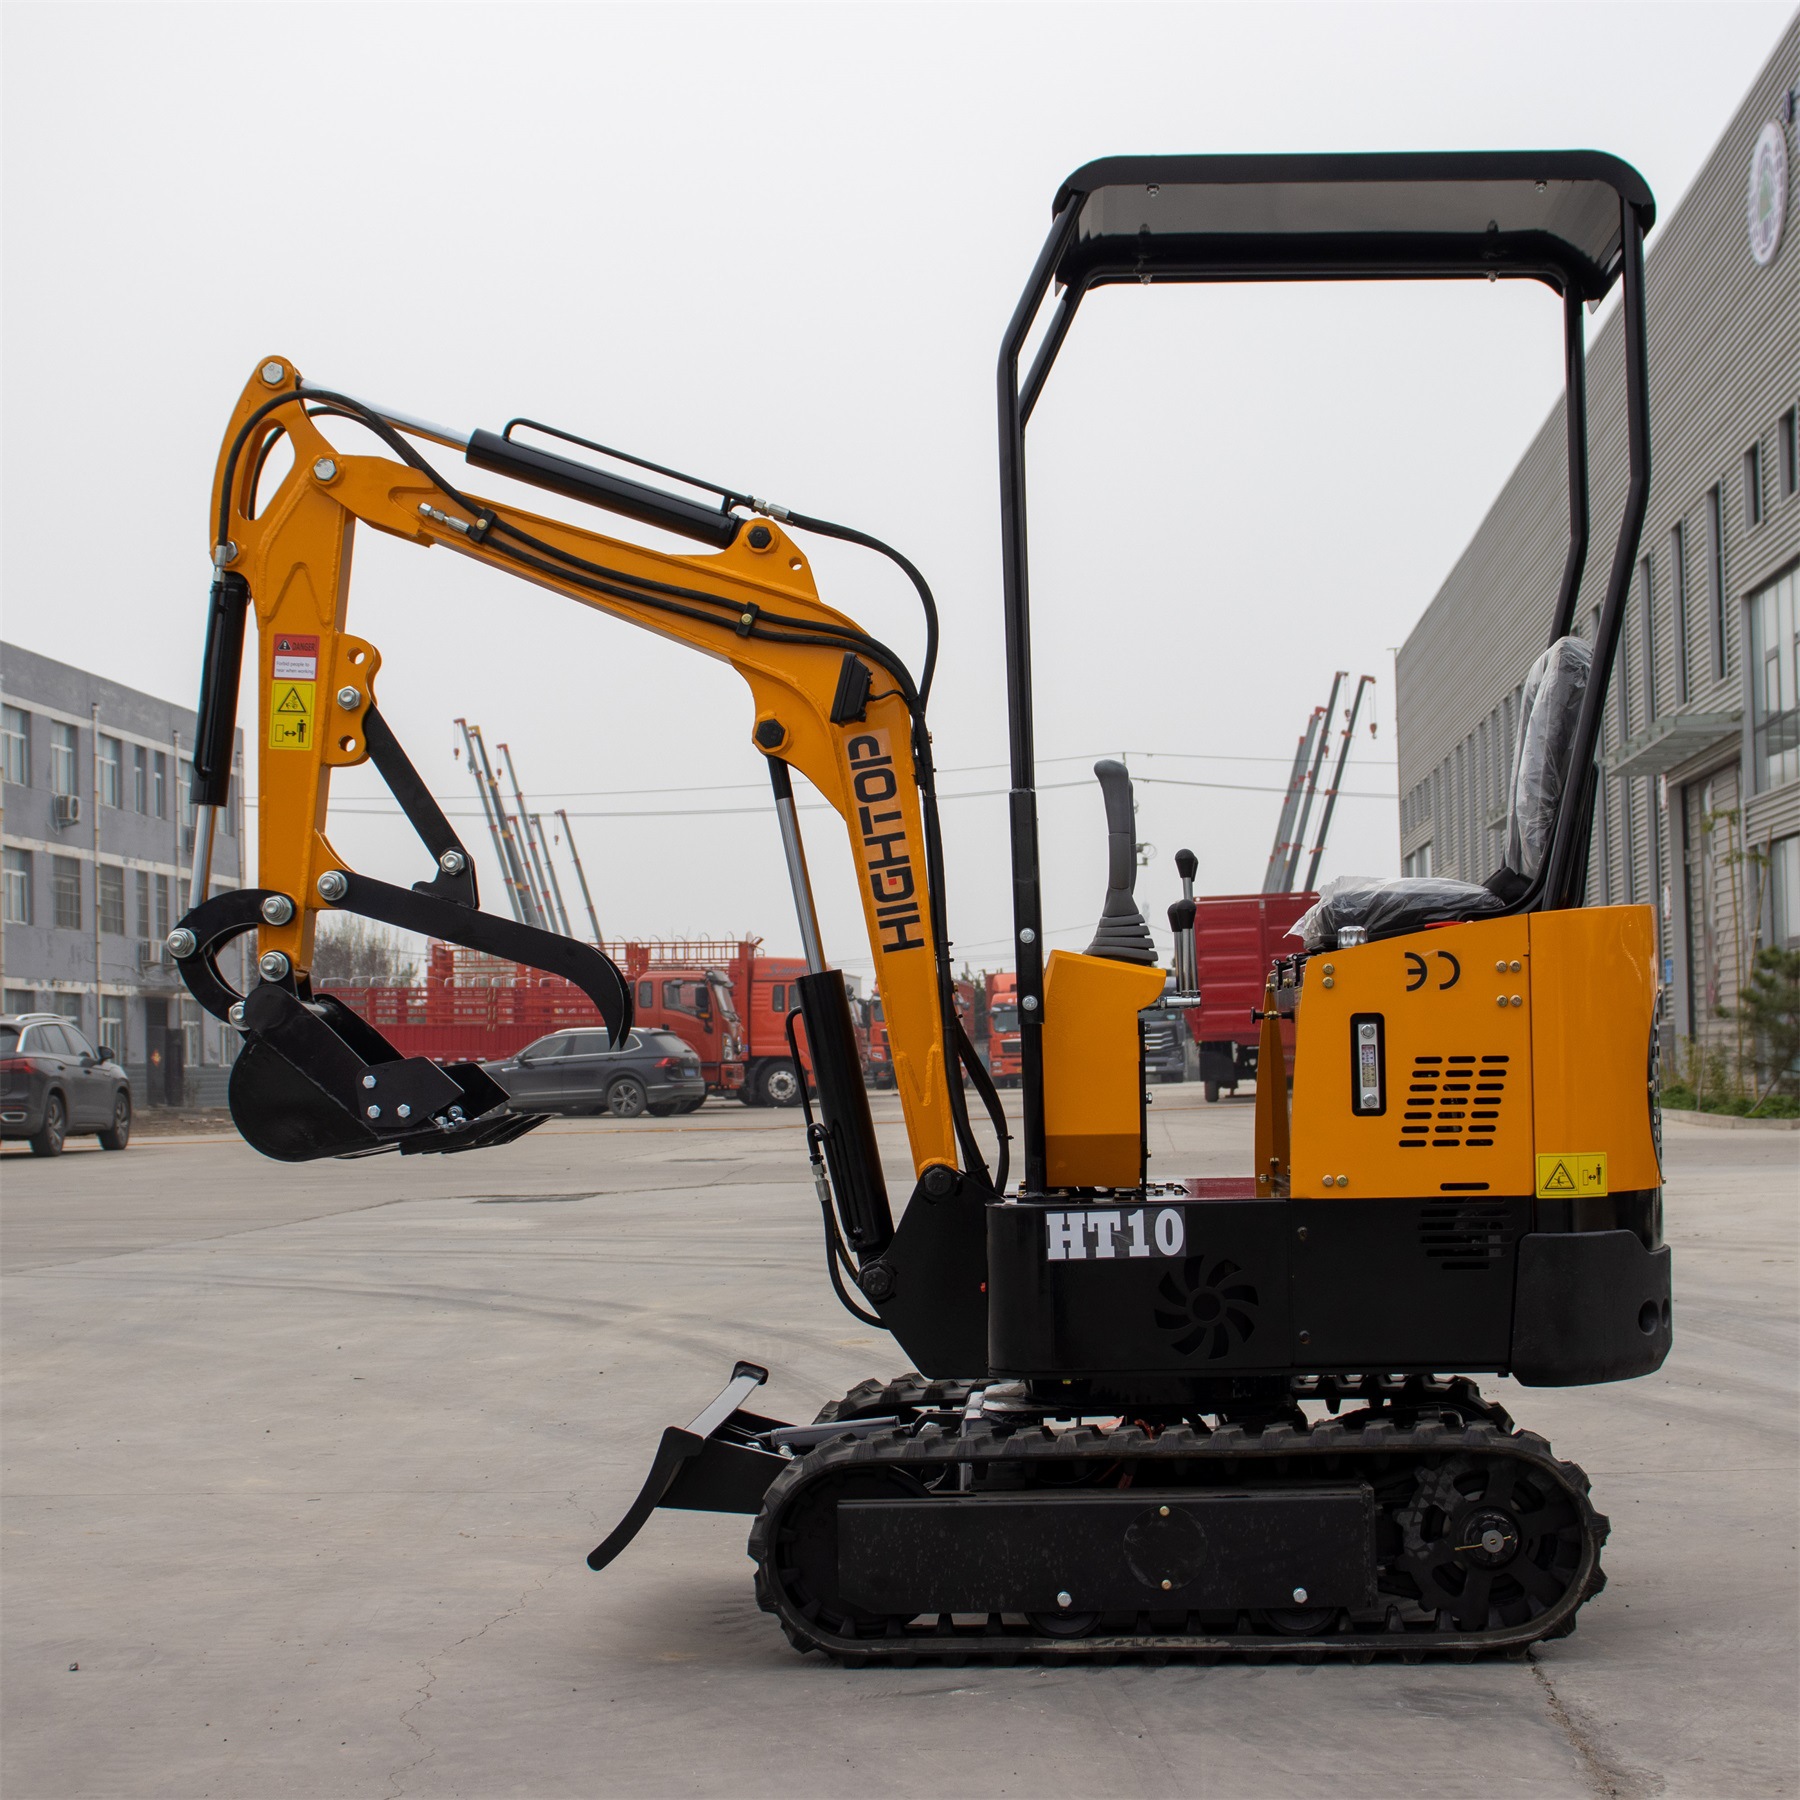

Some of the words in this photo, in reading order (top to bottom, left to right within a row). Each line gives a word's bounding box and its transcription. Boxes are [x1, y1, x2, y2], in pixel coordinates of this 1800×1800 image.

[292, 642, 316, 651] DANGER
[847, 735, 926, 953] HIGHTOP
[1404, 950, 1461, 992] CE
[1046, 1208, 1184, 1260] HT10
